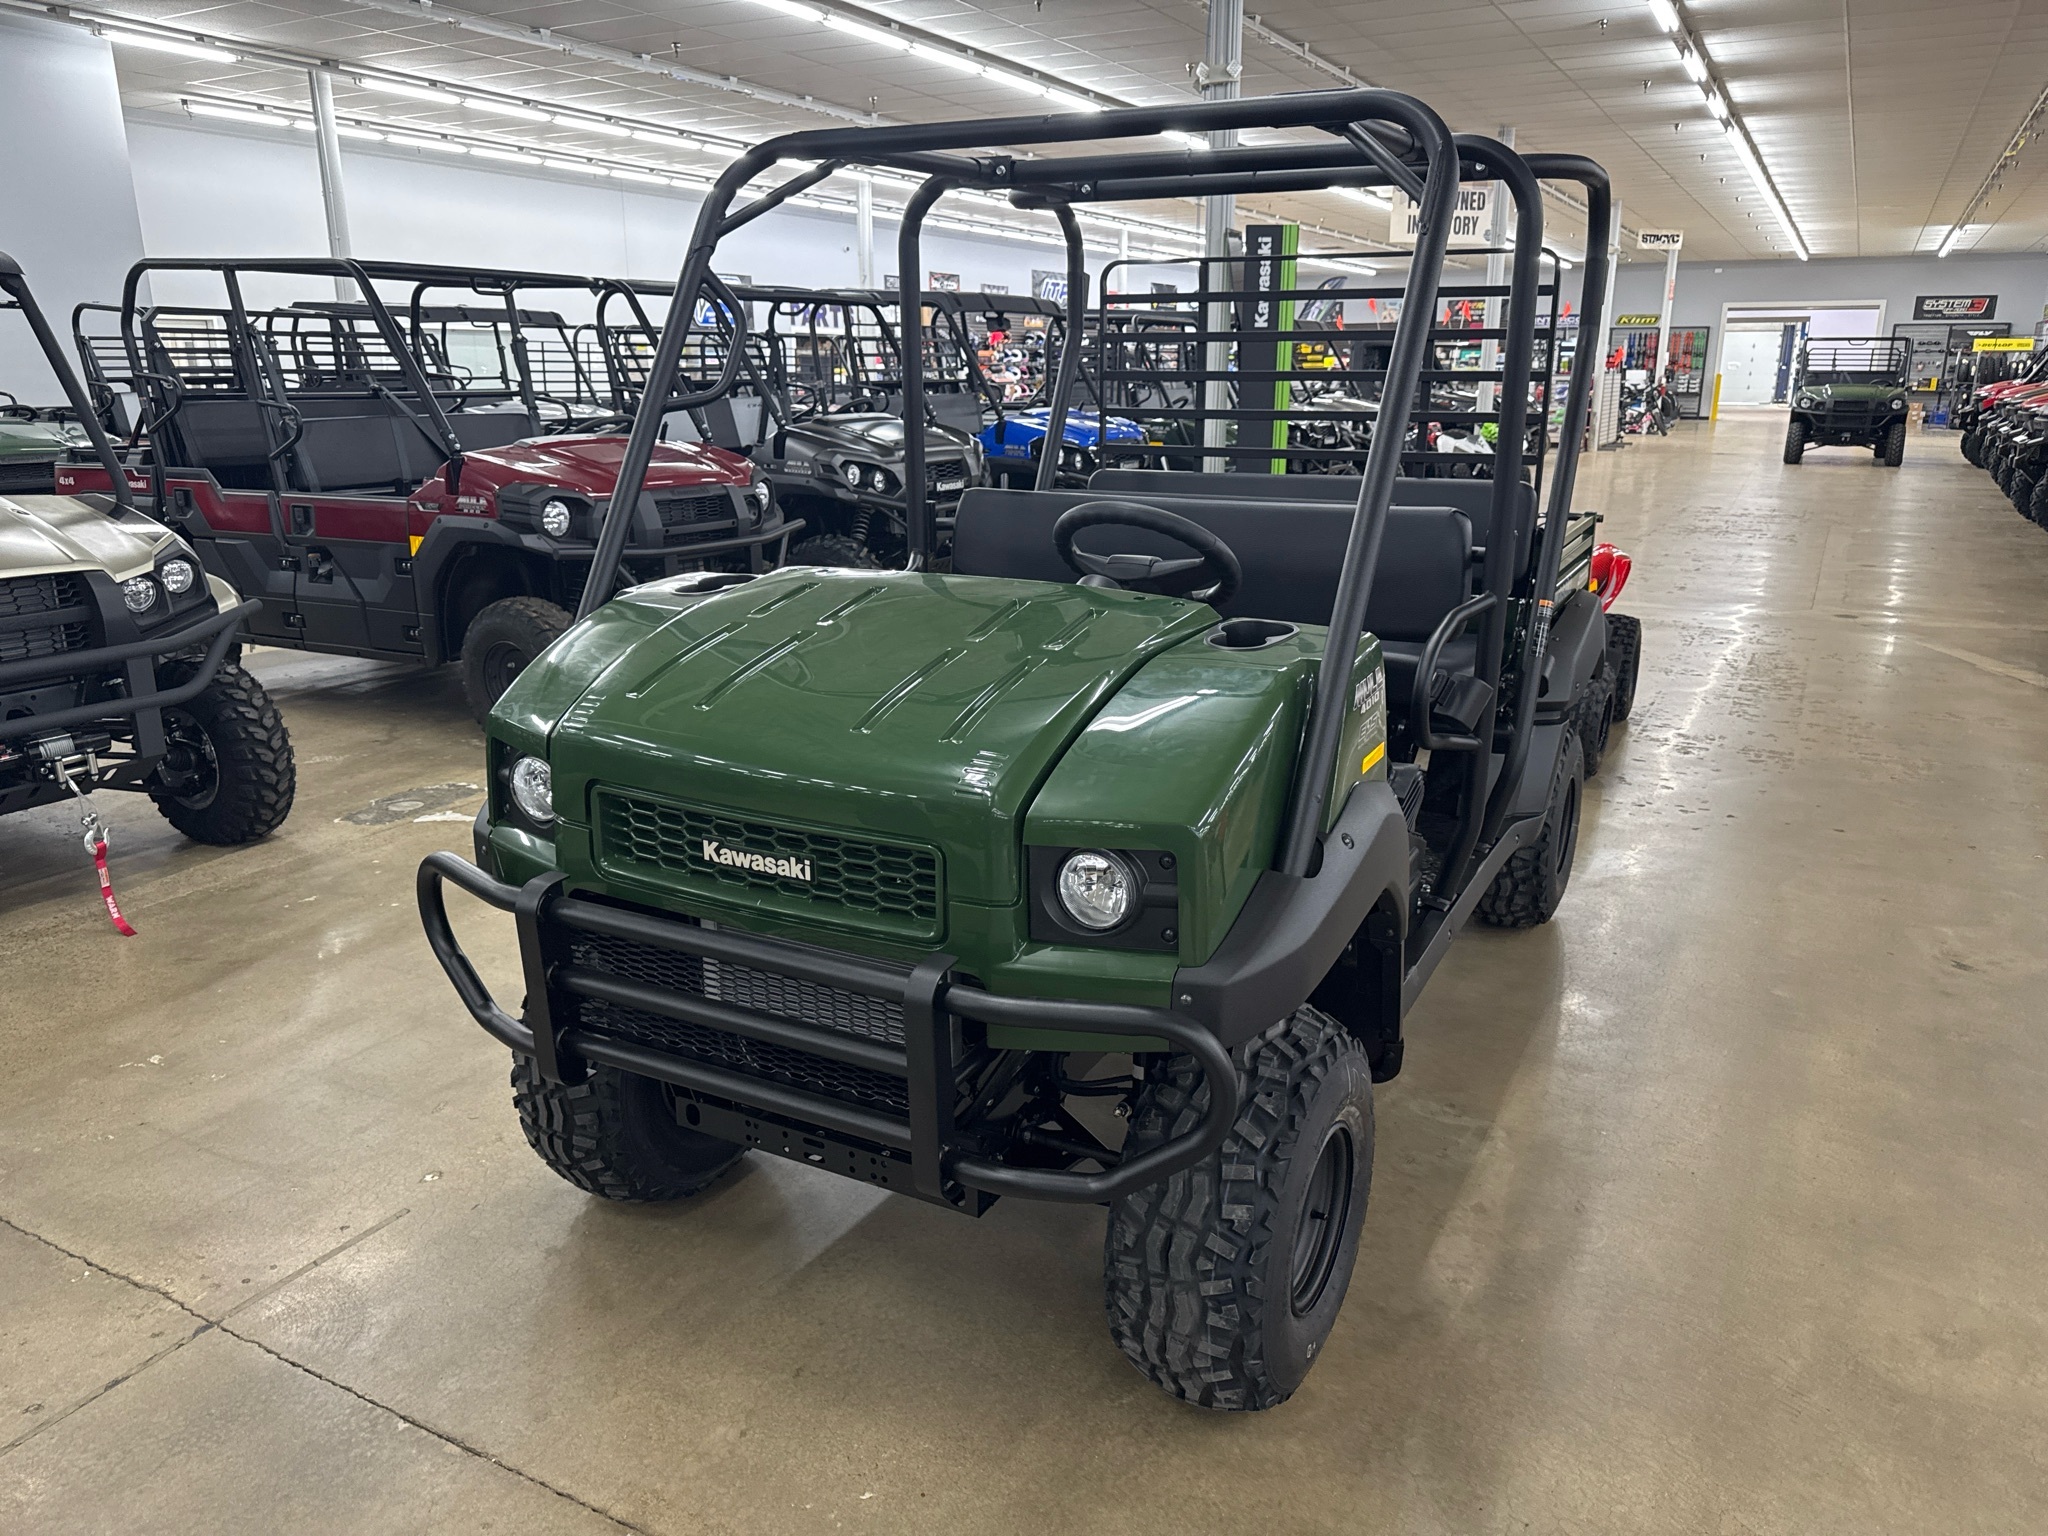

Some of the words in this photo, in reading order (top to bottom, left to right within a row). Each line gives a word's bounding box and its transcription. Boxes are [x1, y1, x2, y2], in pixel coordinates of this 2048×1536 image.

[1407, 214, 1480, 236] INORY
[1923, 299, 1972, 309] SYSTEM
[59, 476, 75, 486] 4x4
[1361, 690, 1380, 715] 4010
[702, 839, 811, 881] Kawasaki
[106, 895, 121, 920] WARN
